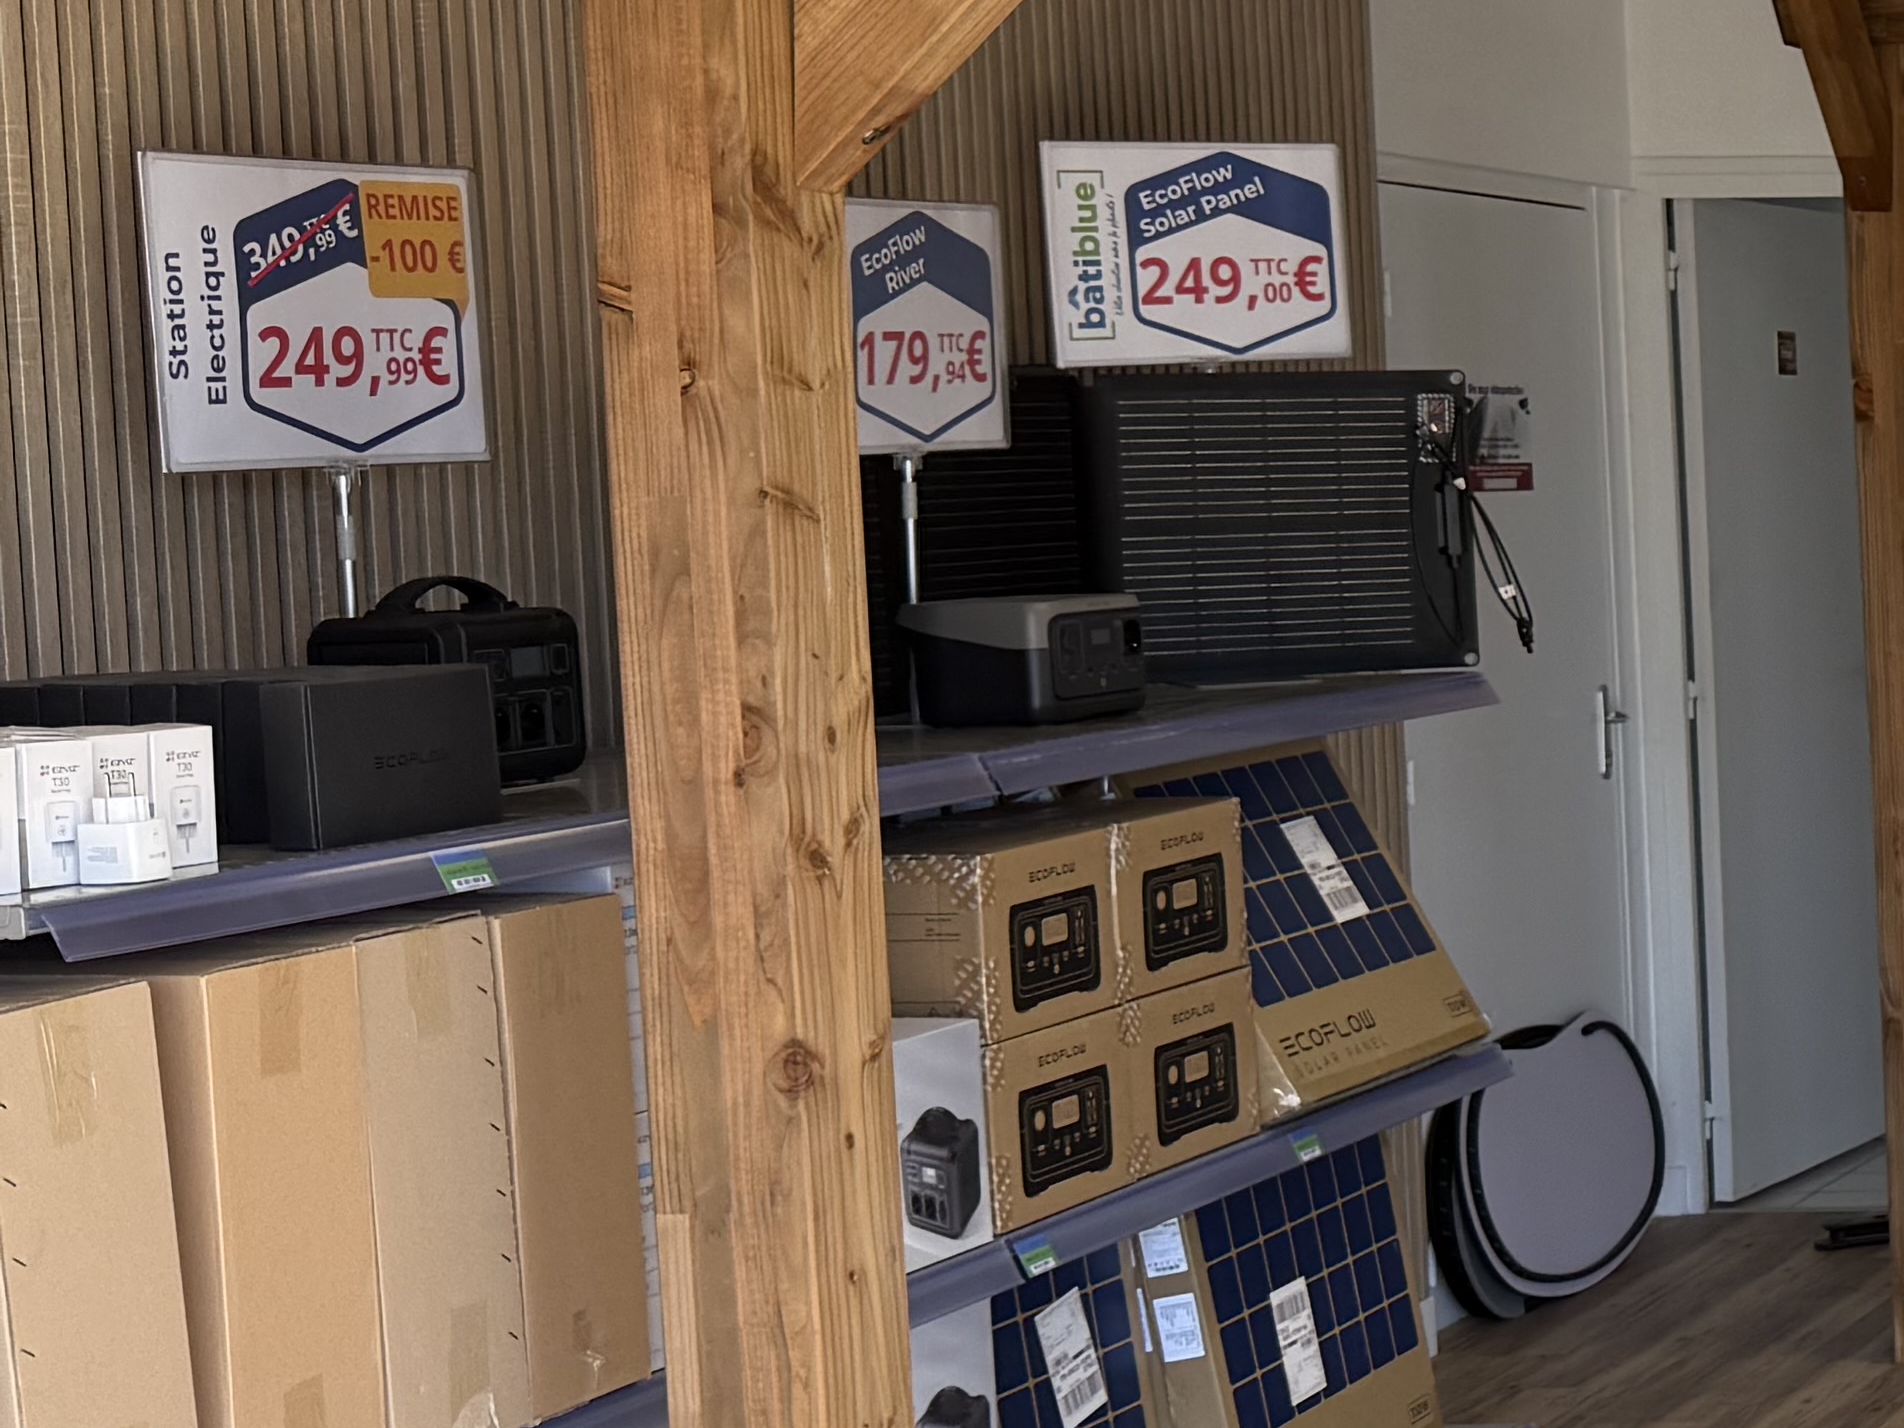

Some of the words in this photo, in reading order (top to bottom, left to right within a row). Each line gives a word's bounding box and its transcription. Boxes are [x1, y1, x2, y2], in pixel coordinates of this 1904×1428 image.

[366, 192, 459, 222] REMISE
[1138, 162, 1234, 211] EcoFlow
[1139, 204, 1197, 239] Solar
[1201, 174, 1265, 217] Panel
[370, 238, 438, 274] -100
[860, 222, 927, 276] EcoFlow
[1067, 182, 1106, 329] bâtiblue
[1249, 257, 1289, 277] TTC
[885, 255, 926, 295] River
[163, 250, 189, 381] Station
[199, 223, 228, 406] Electrique
[371, 328, 413, 354] TTC
[938, 332, 965, 354] TTC
[1279, 1008, 1377, 1058] ECOFLOW
